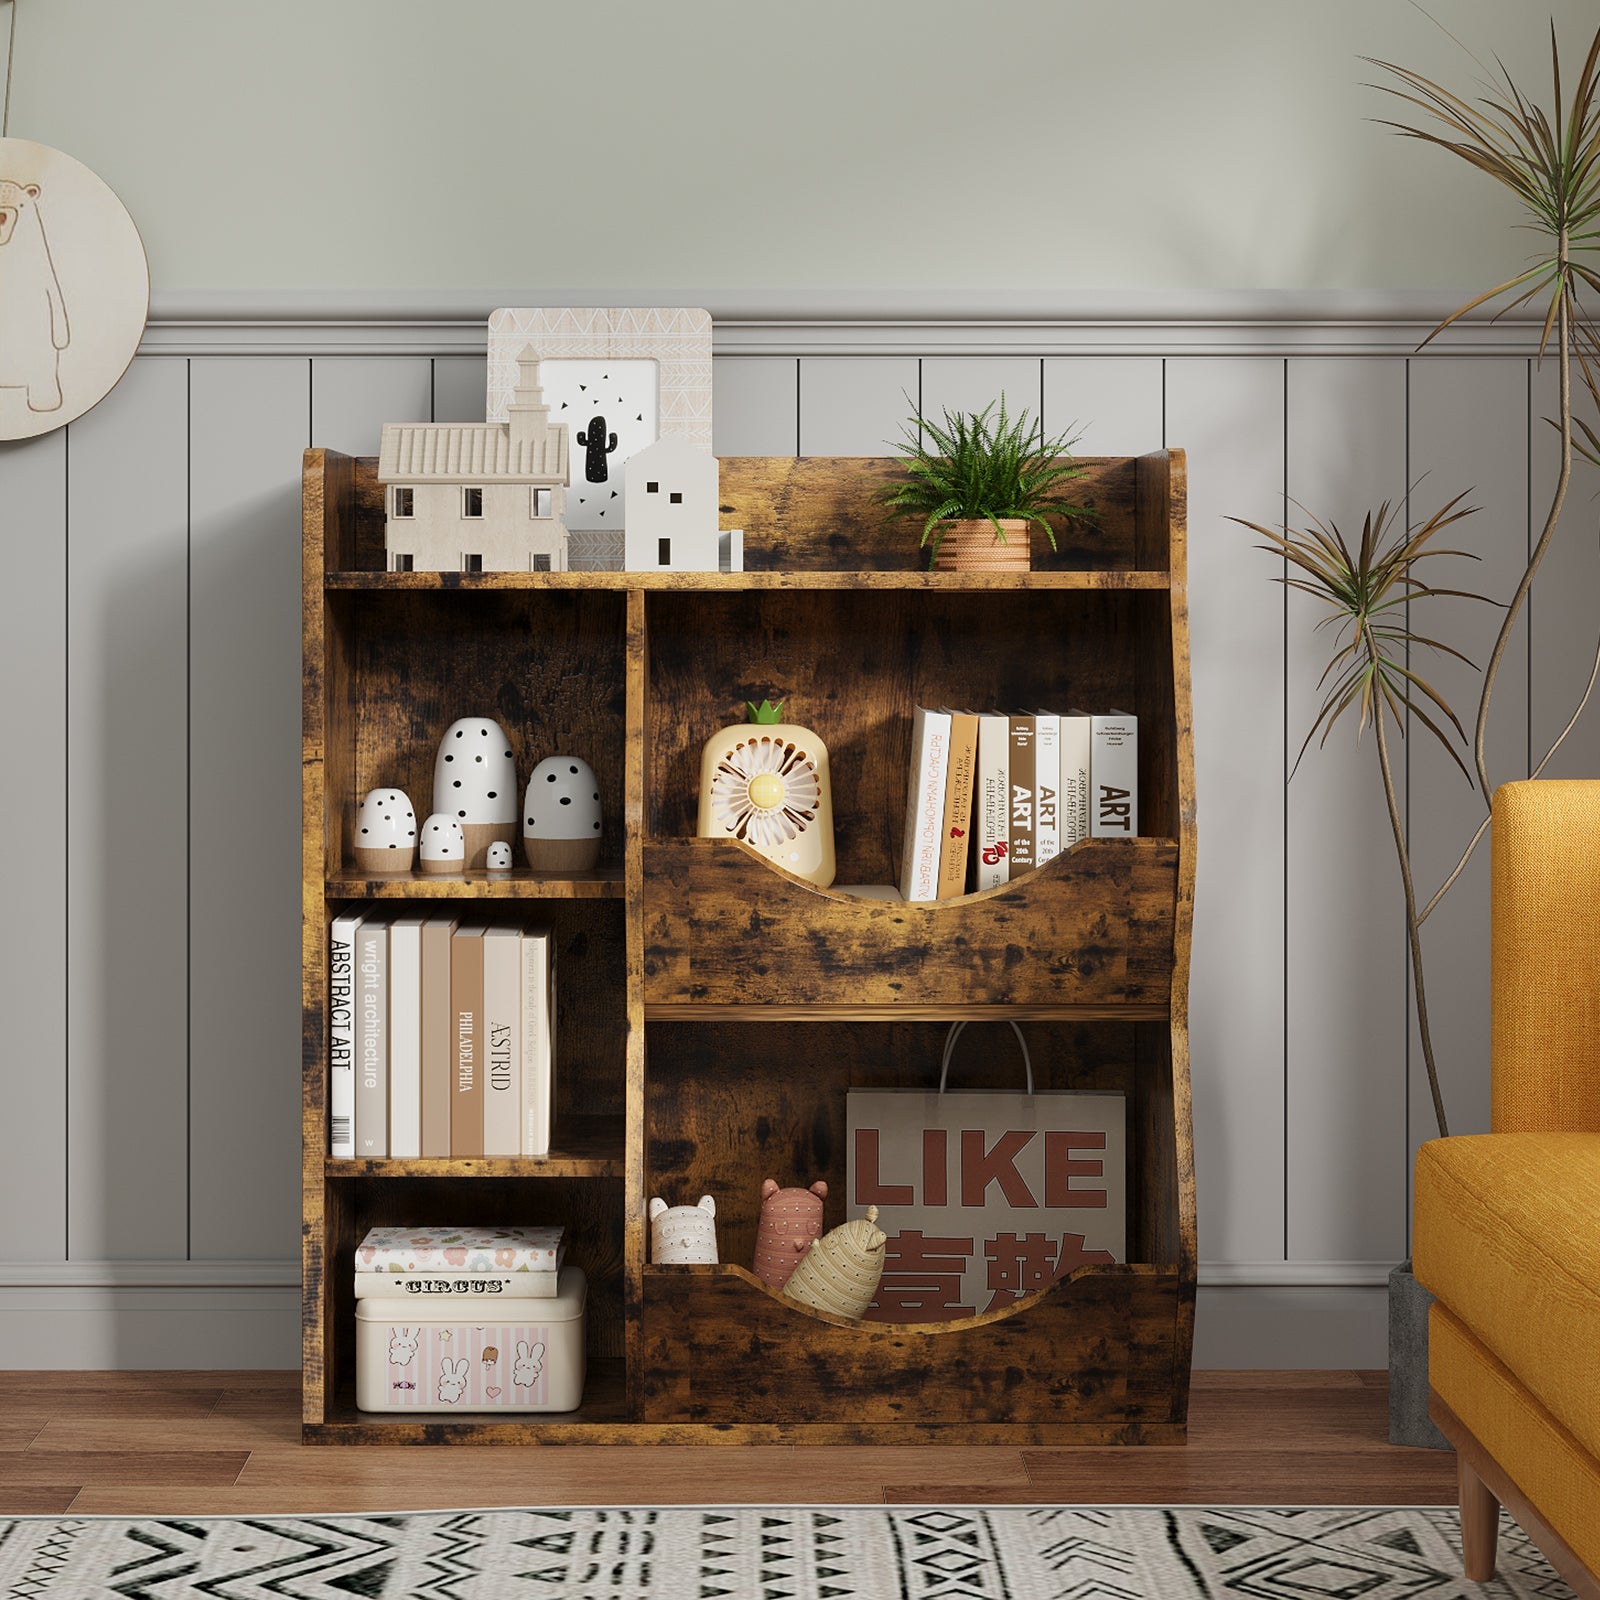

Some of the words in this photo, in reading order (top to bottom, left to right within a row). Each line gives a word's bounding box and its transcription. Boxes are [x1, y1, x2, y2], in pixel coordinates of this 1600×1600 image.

[1012, 784, 1032, 832] ART
[1039, 785, 1056, 831] ART
[1099, 784, 1131, 832] ART
[1011, 856, 1033, 865] Century
[1013, 838, 1020, 846] of
[1021, 838, 1031, 846] the
[331, 940, 351, 1031] ABSTRACT
[361, 940, 381, 989] wright
[331, 1036, 351, 1071] ART
[364, 993, 381, 1089] architecture
[459, 1011, 473, 1093] PHILADELPHIA
[854, 1128, 1108, 1209] LIKE
[404, 1278, 504, 1294] CIRCUS
